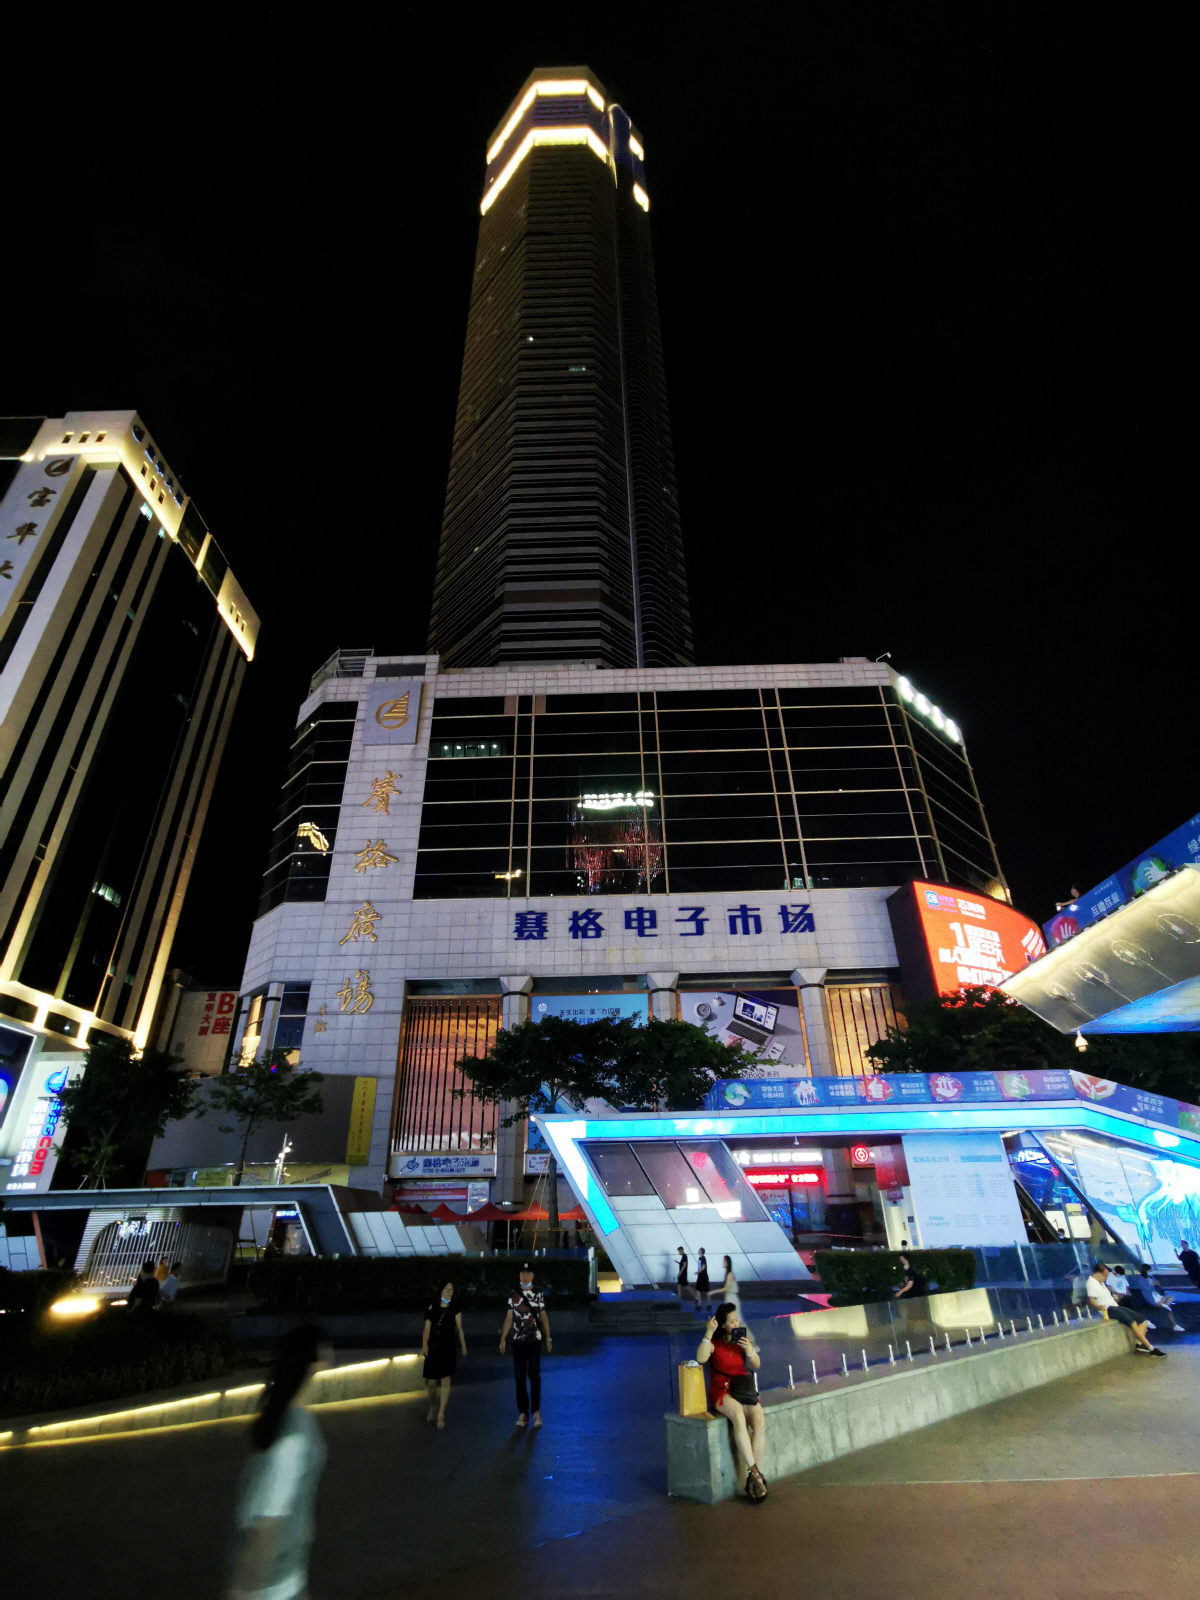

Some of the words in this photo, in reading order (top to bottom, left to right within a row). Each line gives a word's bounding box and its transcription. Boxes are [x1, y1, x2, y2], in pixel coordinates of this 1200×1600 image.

[513, 904, 816, 941] 赛格电子市场
[211, 992, 236, 1035] B座
